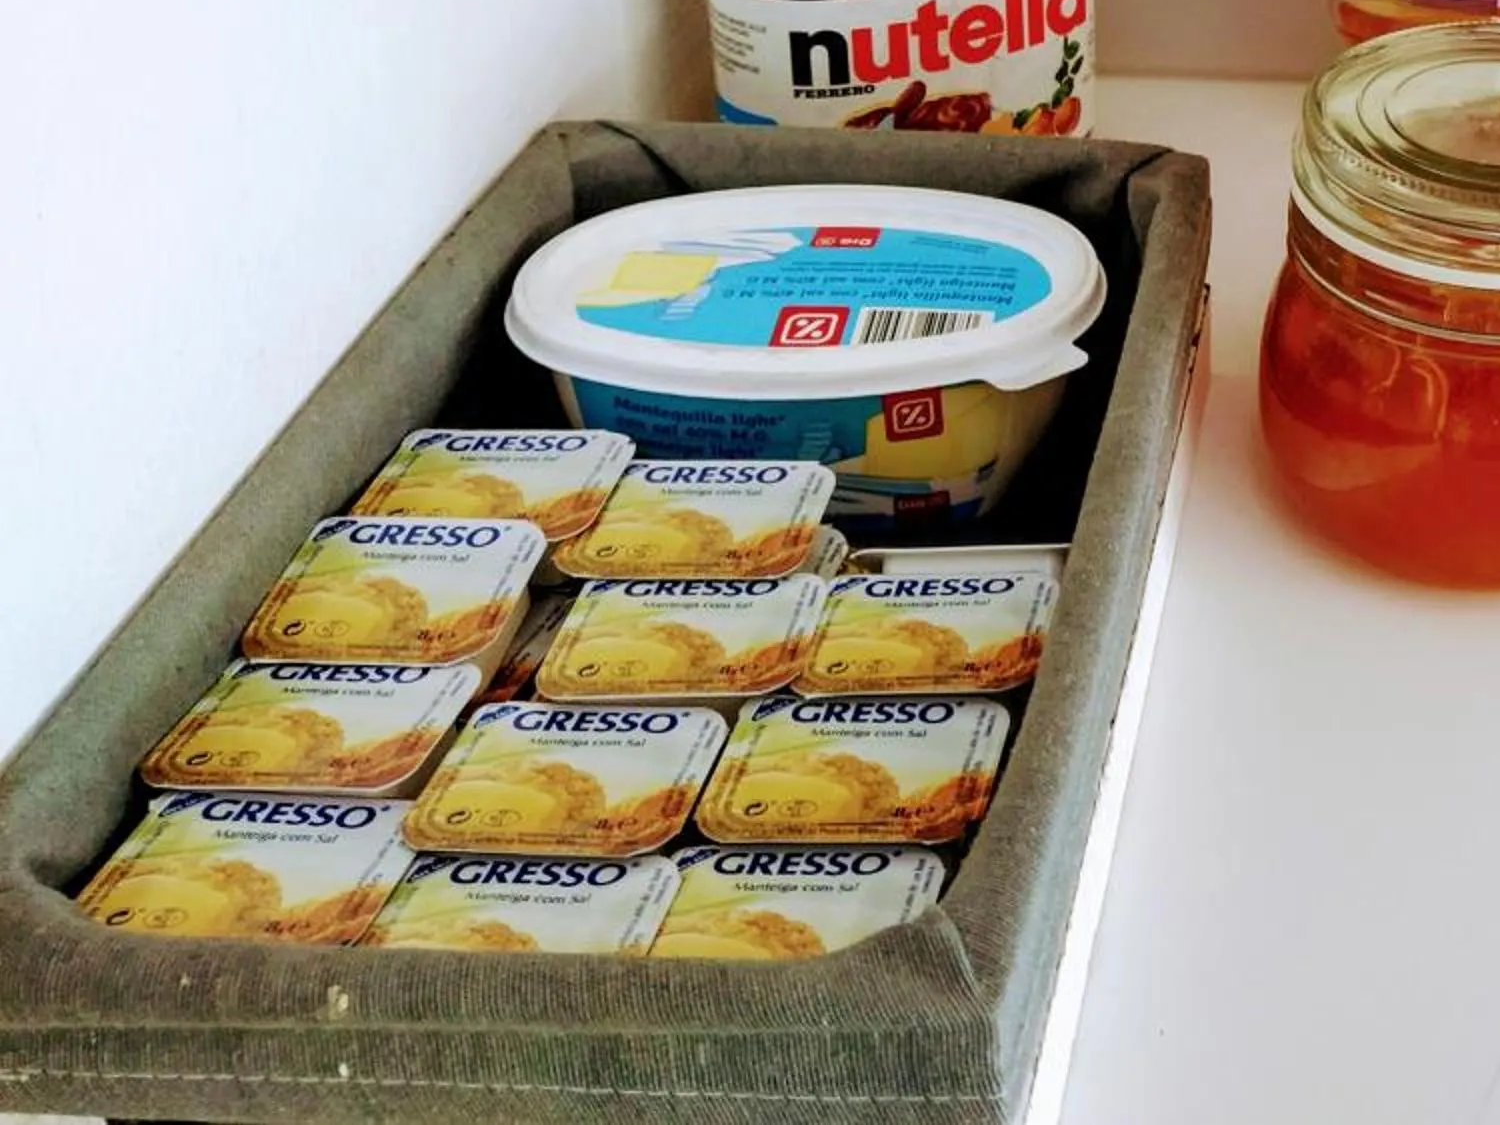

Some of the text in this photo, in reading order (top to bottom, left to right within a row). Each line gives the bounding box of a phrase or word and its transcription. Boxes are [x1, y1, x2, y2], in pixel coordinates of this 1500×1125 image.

[793, 85, 875, 99] FERRERO
[445, 435, 588, 452] GRESSO
[644, 466, 788, 484] GRESSO
[349, 524, 501, 548] GRESSO
[624, 579, 779, 596] GRESSO
[865, 578, 1015, 597] GRESSO
[269, 665, 430, 684] GRESSO
[512, 710, 679, 734] GRESSO
[791, 701, 955, 724] GRESSO
[201, 798, 377, 829] GRESSO
[449, 860, 627, 887] GRESSO
[714, 852, 889, 876] GRESSO
